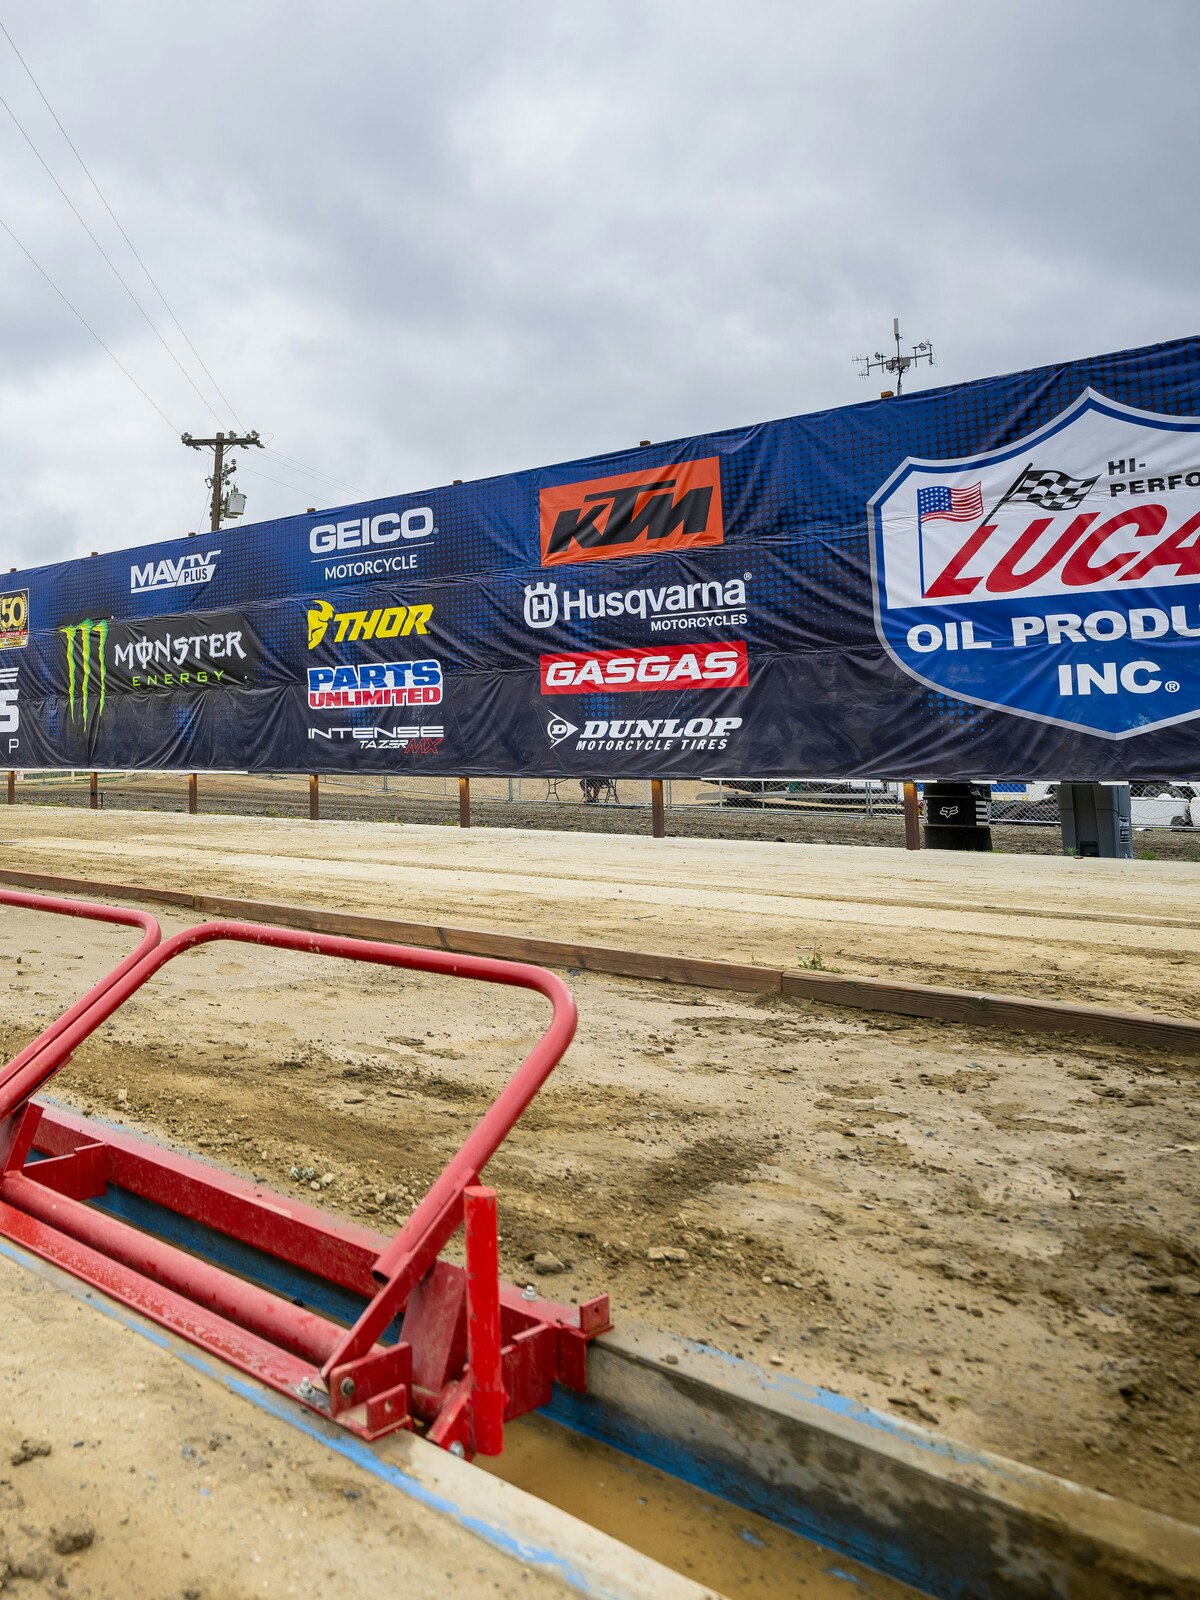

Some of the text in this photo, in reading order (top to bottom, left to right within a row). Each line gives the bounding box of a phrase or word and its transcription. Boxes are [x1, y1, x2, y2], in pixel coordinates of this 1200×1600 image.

[1108, 457, 1146, 475] HI-
[309, 507, 434, 554] GEICO
[546, 479, 714, 554] KTM
[130, 550, 222, 589] MAVTV
[183, 568, 208, 583] PLUS
[325, 554, 418, 580] MOTORCYCLE
[0, 596, 25, 628] 50
[563, 579, 746, 621] Husqvarna
[333, 604, 435, 643] THOR
[651, 614, 748, 632] MOTORCYCLES
[906, 621, 992, 653] OIL
[113, 630, 247, 670] MONSTER
[132, 670, 225, 687] ENERGY
[308, 660, 443, 691] PARTS
[546, 652, 738, 687] GASGAS
[309, 687, 442, 707] UNLIMITED
[308, 726, 444, 739] INTENSE
[580, 717, 743, 739] DUNLOP
[576, 739, 728, 751] MOTORCYCLE TIRES
